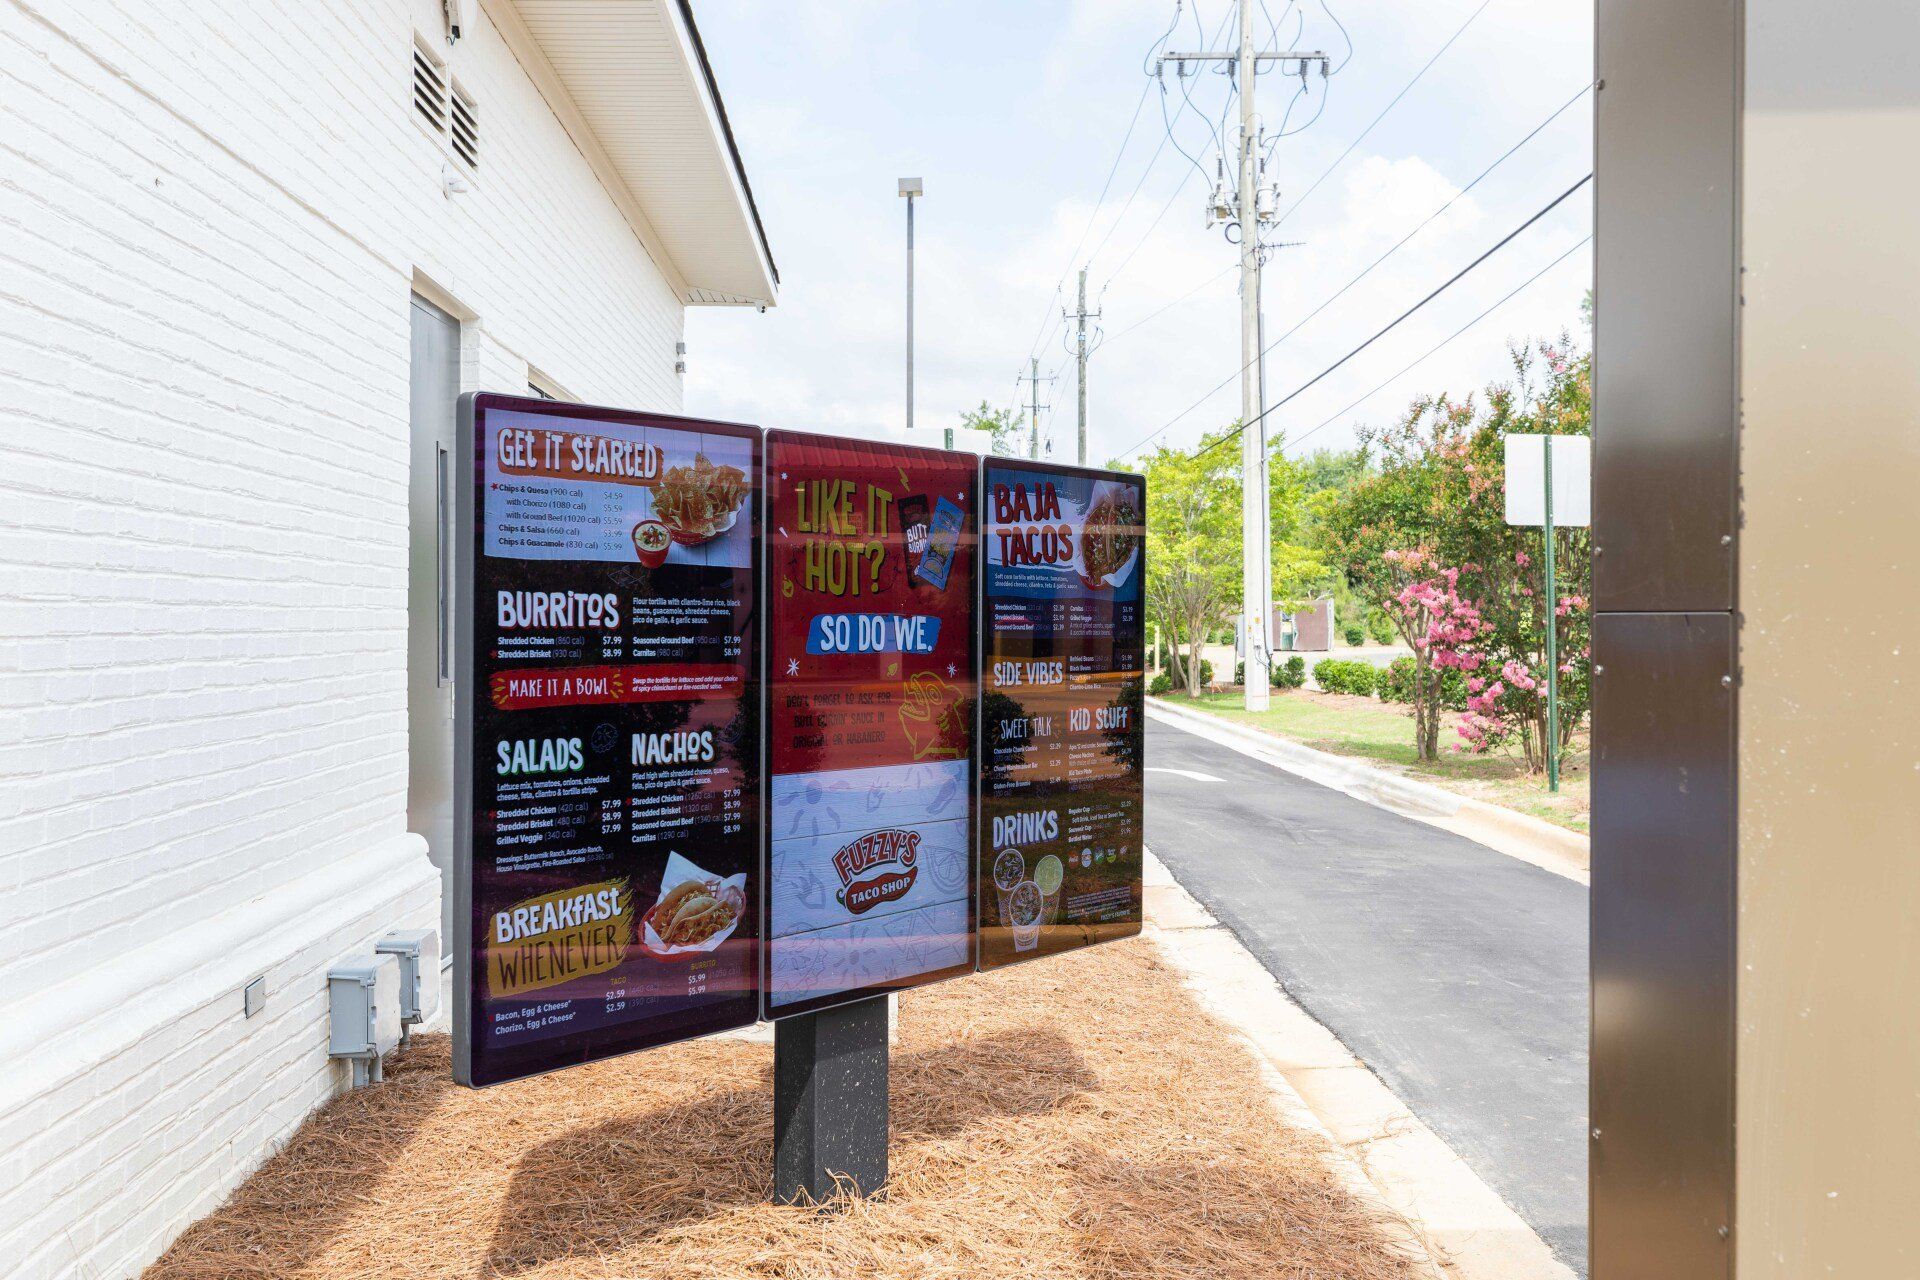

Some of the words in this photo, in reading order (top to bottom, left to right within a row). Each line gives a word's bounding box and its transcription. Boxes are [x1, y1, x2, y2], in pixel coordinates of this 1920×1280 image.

[499, 484, 519, 494] Chips
[527, 486, 549, 496] Queso
[550, 488, 568, 496] (900
[569, 488, 583, 498] cal)
[604, 492, 622, 500] $4.59
[506, 498, 521, 506] with
[522, 500, 548, 508] Chorizo
[549, 501, 571, 510] (1080
[572, 502, 587, 512] cal)
[604, 506, 622, 514] $5.59
[797, 479, 857, 537] LIKE
[868, 483, 893, 539] IT
[994, 482, 1062, 524] BAJA
[506, 512, 521, 520] with
[522, 512, 546, 521] Ground
[548, 514, 562, 522] Beef
[564, 514, 586, 524] (1020
[587, 516, 601, 525] cal)
[604, 517, 622, 526] $5.59
[499, 524, 519, 534] Chips
[526, 526, 545, 534] Salsa
[547, 527, 564, 536] (660
[566, 528, 580, 537] cal)
[604, 529, 622, 538] $3.99
[906, 523, 928, 542] BUTT
[499, 538, 519, 548] Chips
[526, 540, 565, 548] Guacamole
[566, 540, 583, 550] (830
[584, 541, 599, 550] cal)
[604, 542, 622, 551] $5.99
[996, 524, 1074, 568] TACOS
[805, 538, 886, 597] HOT?
[632, 598, 648, 606] Flour
[649, 598, 666, 606] tortilla
[668, 598, 680, 606] with
[632, 616, 646, 626] pico
[646, 616, 654, 624] de
[676, 616, 691, 626] garlic
[498, 636, 529, 646] Shredded
[530, 636, 555, 646] Chicken
[602, 636, 622, 646] $7.99
[632, 636, 660, 645] Seasoned
[660, 636, 681, 645] Ground
[681, 636, 694, 645] Beef
[724, 636, 741, 644] $7.99
[820, 615, 851, 652] SO
[858, 615, 886, 652] DO
[894, 616, 933, 652] WE.
[498, 650, 529, 659] Shredded
[530, 650, 552, 658] Brisket
[602, 649, 622, 658] $8.99
[632, 648, 656, 658] Carnitas
[724, 648, 741, 656] $8.99
[510, 678, 542, 698] MAKE
[547, 679, 557, 696] IT
[562, 679, 571, 696] A
[577, 678, 609, 696] BOWL
[851, 712, 874, 726] SAUCE
[1000, 718, 1028, 740] SWEET
[1033, 716, 1052, 737] TALK
[496, 738, 584, 776] SALADS
[632, 730, 716, 766] NACHOS
[632, 796, 660, 806] Shredded
[661, 794, 684, 803] Chicken
[724, 788, 741, 798] $7.99
[496, 808, 529, 818] Shredded
[530, 806, 556, 816] Chicken
[602, 799, 622, 810] $7.99
[632, 808, 660, 818] Shredded
[661, 806, 682, 816] Brisket
[724, 800, 741, 810] $8.99
[496, 820, 529, 832] Shredded
[530, 818, 554, 828] Brisket
[602, 812, 622, 822] $8.99
[632, 821, 660, 831] Seasoned
[660, 819, 680, 828] Ground
[681, 817, 694, 826] Beef
[724, 812, 741, 822] $7.99
[496, 834, 518, 846] Grilled
[520, 832, 543, 844] Veggie
[602, 824, 622, 834] $7.99
[632, 834, 656, 843] Carnitas
[724, 824, 741, 834] $8.99
[832, 830, 920, 887] FUZZY'S
[851, 887, 880, 904] TACO
[882, 876, 910, 894] SHOP
[498, 924, 622, 991] WHENEVER
[496, 1010, 520, 1022] Bacon,
[522, 1008, 536, 1018] Egg
[536, 1006, 542, 1014] &
[606, 989, 626, 1000] $2.59
[688, 973, 706, 984] $5.99
[496, 1023, 526, 1036] Chorizo,
[527, 1020, 540, 1030] Egg
[542, 1017, 546, 1026] &
[606, 1002, 626, 1014] $2.59
[688, 985, 706, 996] $5.99
